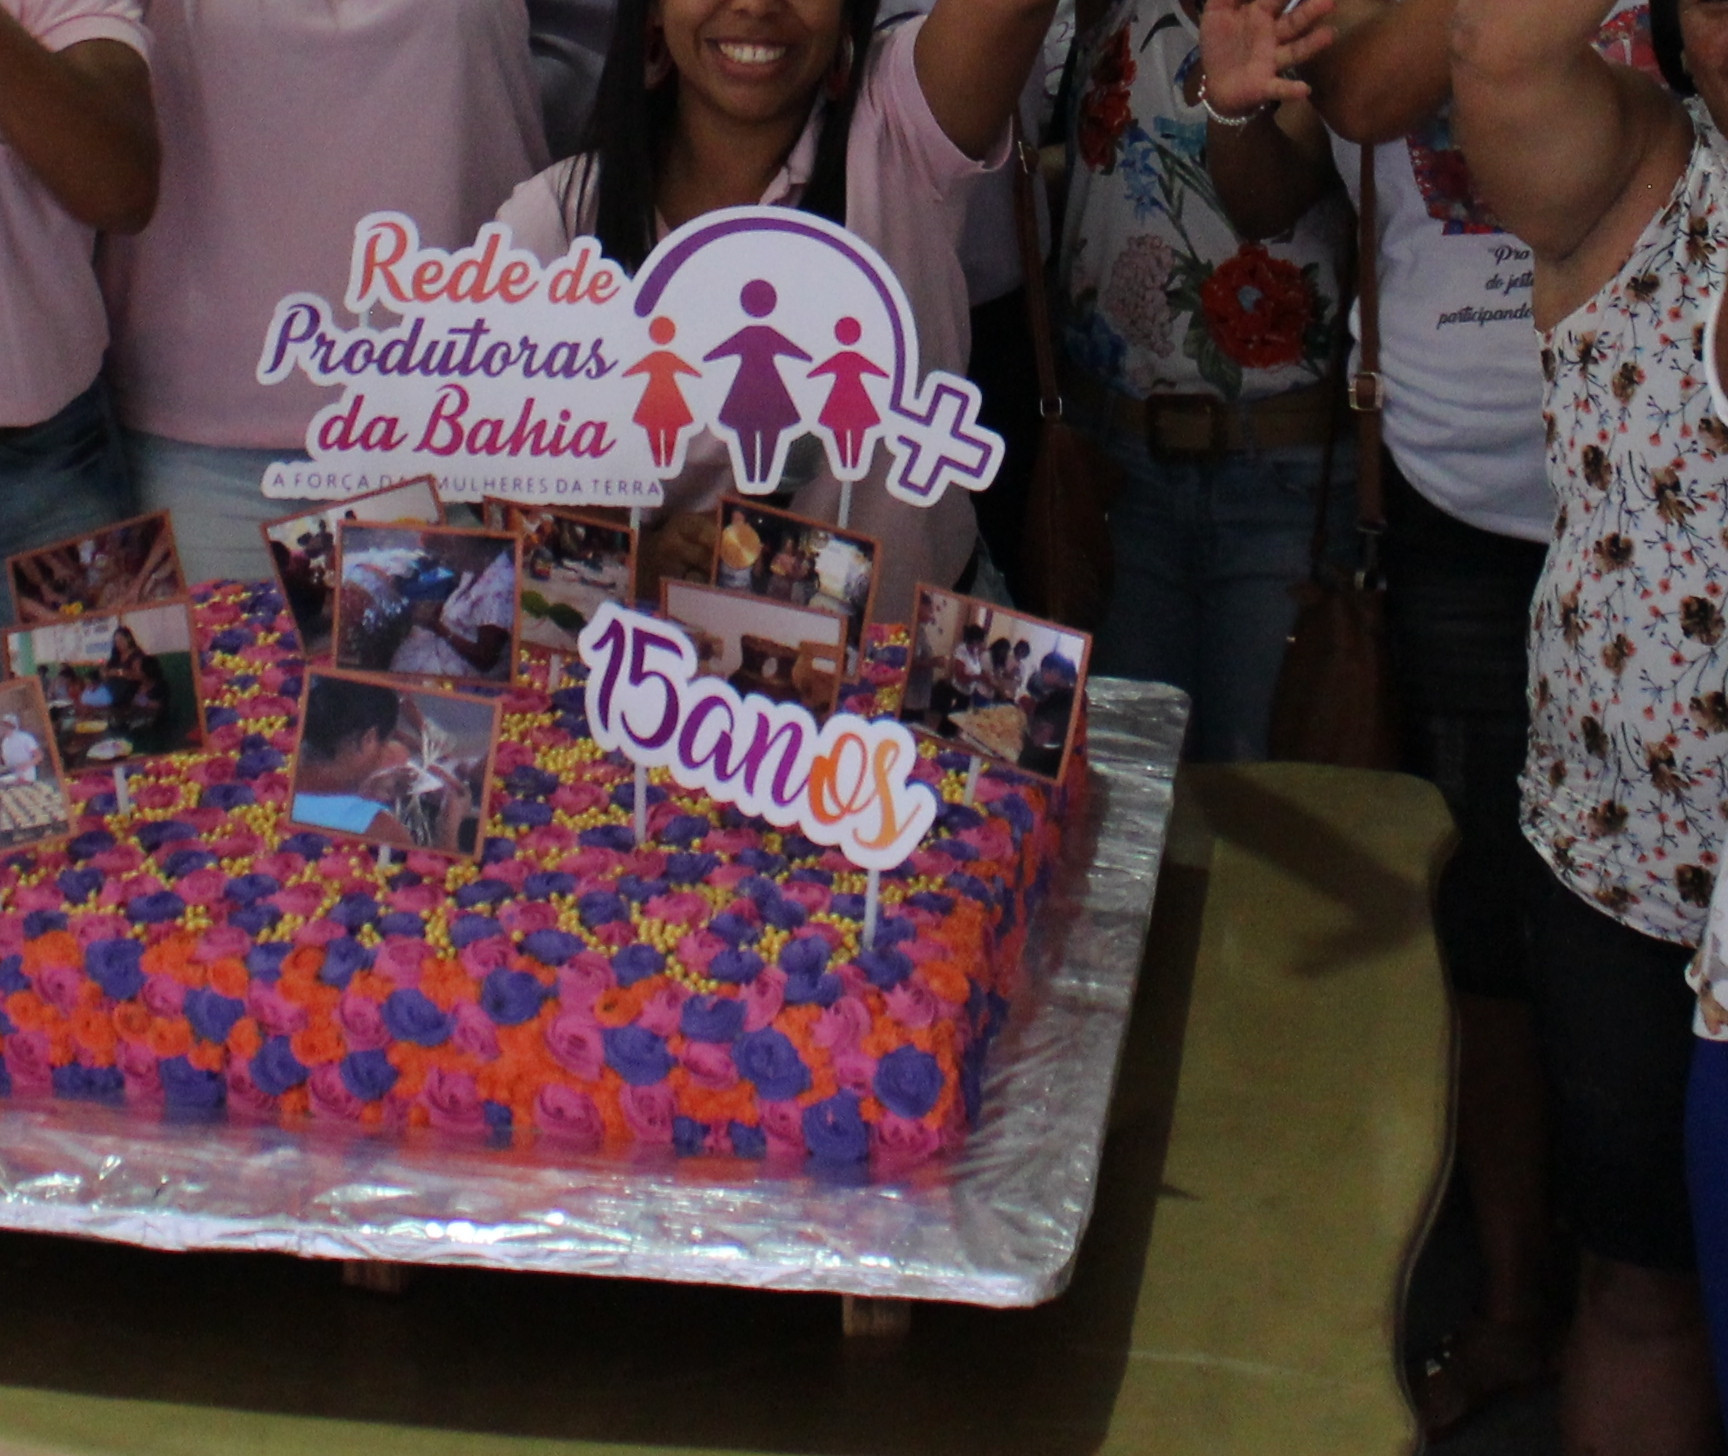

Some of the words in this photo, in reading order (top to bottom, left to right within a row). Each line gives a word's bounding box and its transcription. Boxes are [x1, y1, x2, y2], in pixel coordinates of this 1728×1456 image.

[355, 221, 538, 305] Rede
[548, 248, 620, 305] de
[264, 303, 619, 380] Produtoras
[316, 394, 408, 453] da
[413, 383, 617, 459] Bahia
[273, 473, 286, 488] A
[294, 473, 371, 492] FORÇA
[556, 478, 583, 495] DA
[592, 479, 661, 496] TERRA
